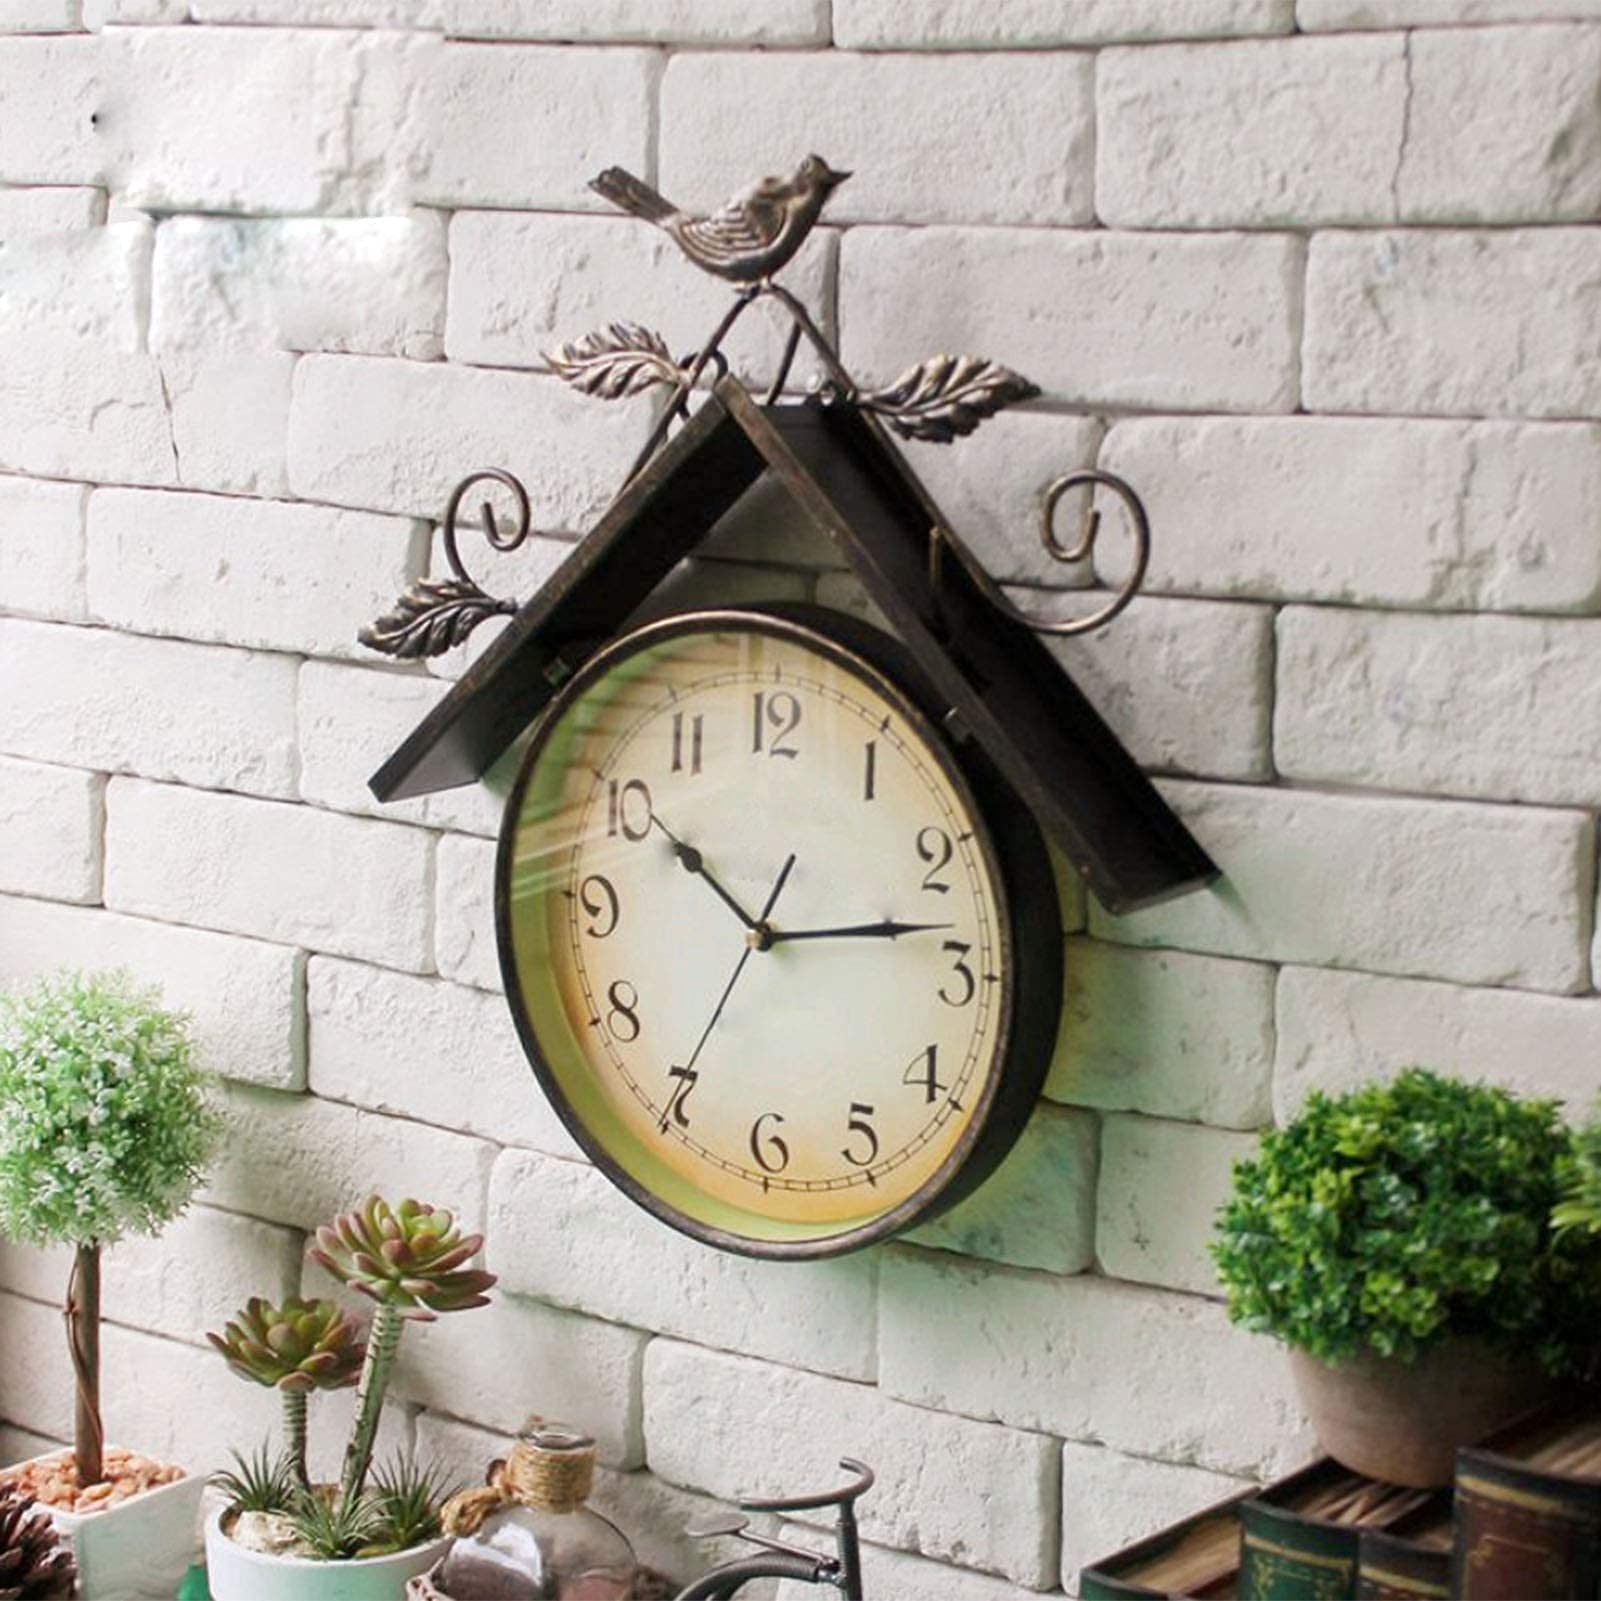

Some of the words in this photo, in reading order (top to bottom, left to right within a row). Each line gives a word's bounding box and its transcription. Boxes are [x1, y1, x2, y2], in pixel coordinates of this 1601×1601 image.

[672, 712, 704, 774] 11
[753, 692, 800, 758] 12
[865, 741, 876, 800] 1
[607, 779, 652, 842] 10
[917, 827, 953, 893] 2
[580, 875, 619, 938] 9
[939, 941, 975, 1006] 3
[607, 981, 640, 1042] 8
[669, 1066, 698, 1127] 7
[904, 1045, 948, 1102] 4
[751, 1114, 790, 1173] 6
[842, 1104, 879, 1165] 5
